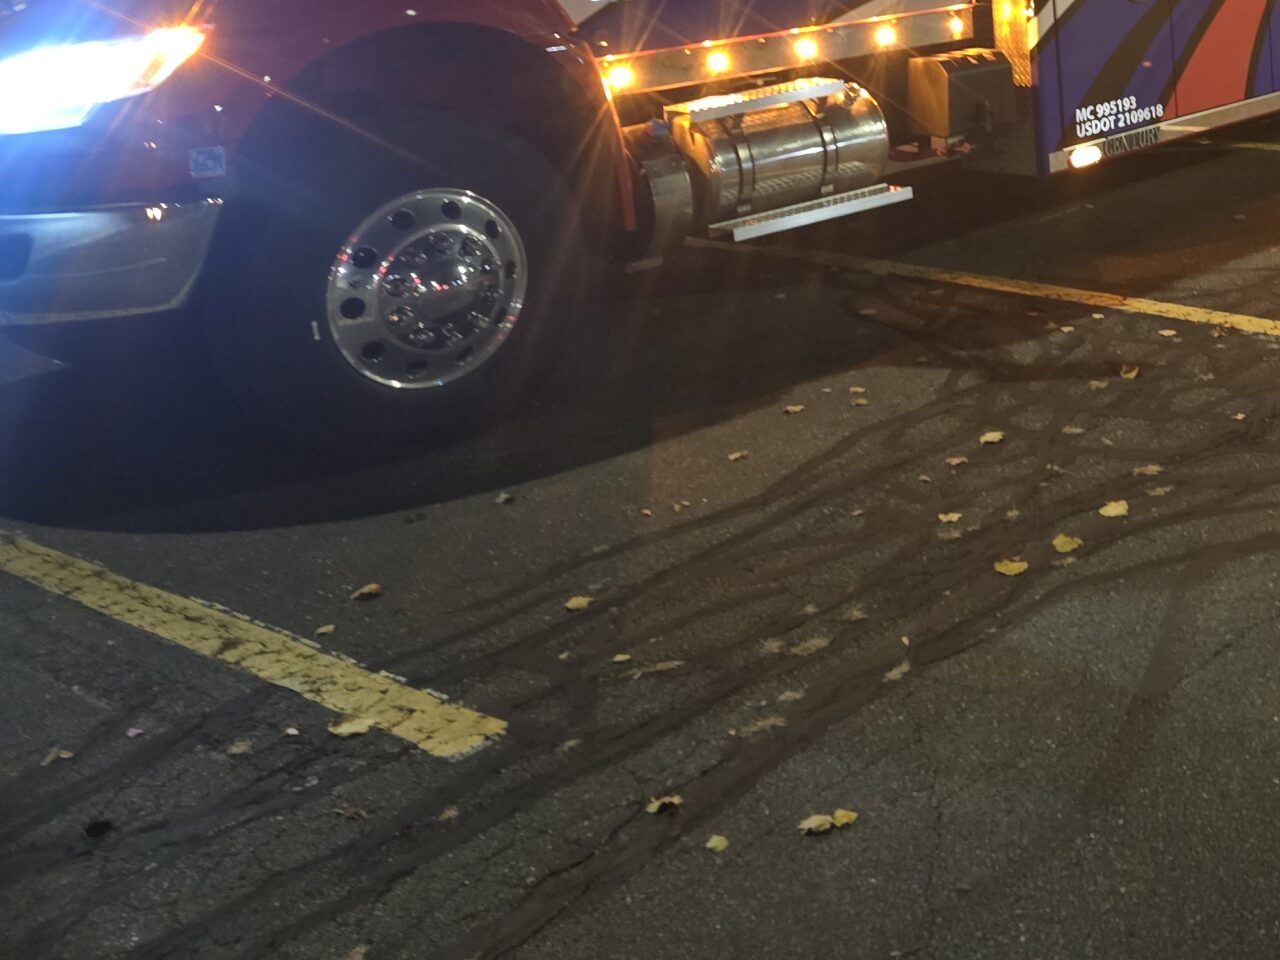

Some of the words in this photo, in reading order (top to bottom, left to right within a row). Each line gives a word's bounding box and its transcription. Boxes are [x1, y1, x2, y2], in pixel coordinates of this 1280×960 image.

[1075, 105, 1094, 123] MC
[1096, 96, 1136, 116] 995193
[1076, 116, 1116, 138] USDOT
[1117, 104, 1163, 127] 2109618
